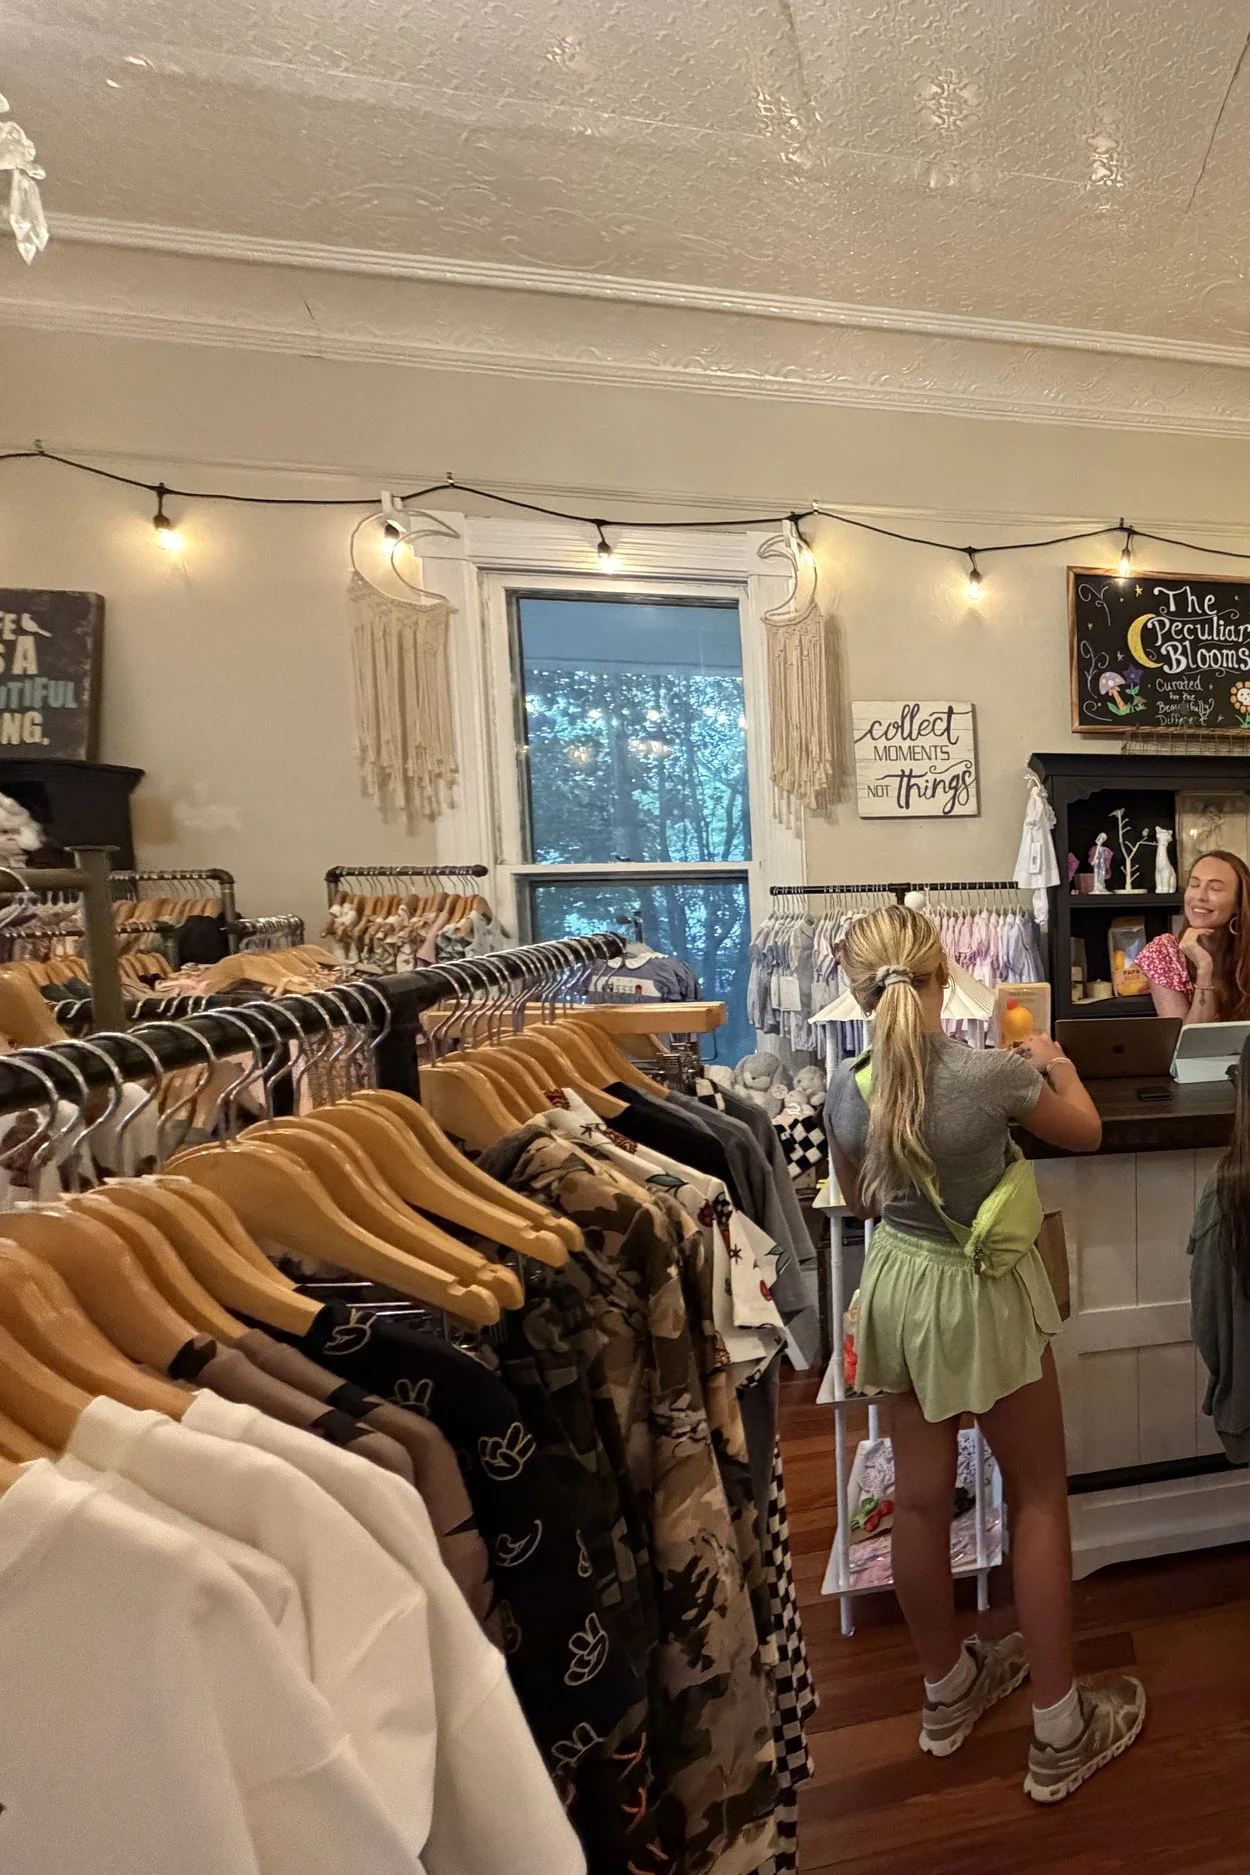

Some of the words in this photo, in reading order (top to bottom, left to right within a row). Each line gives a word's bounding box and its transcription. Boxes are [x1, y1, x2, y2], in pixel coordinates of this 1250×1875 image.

[1153, 585, 1218, 615] The
[12, 635, 38, 675] A
[1156, 675, 1203, 692] Curated
[854, 703, 973, 745] collect
[874, 745, 950, 761] MOMENTS
[867, 785, 890, 798] NOT
[875, 766, 976, 815] things
